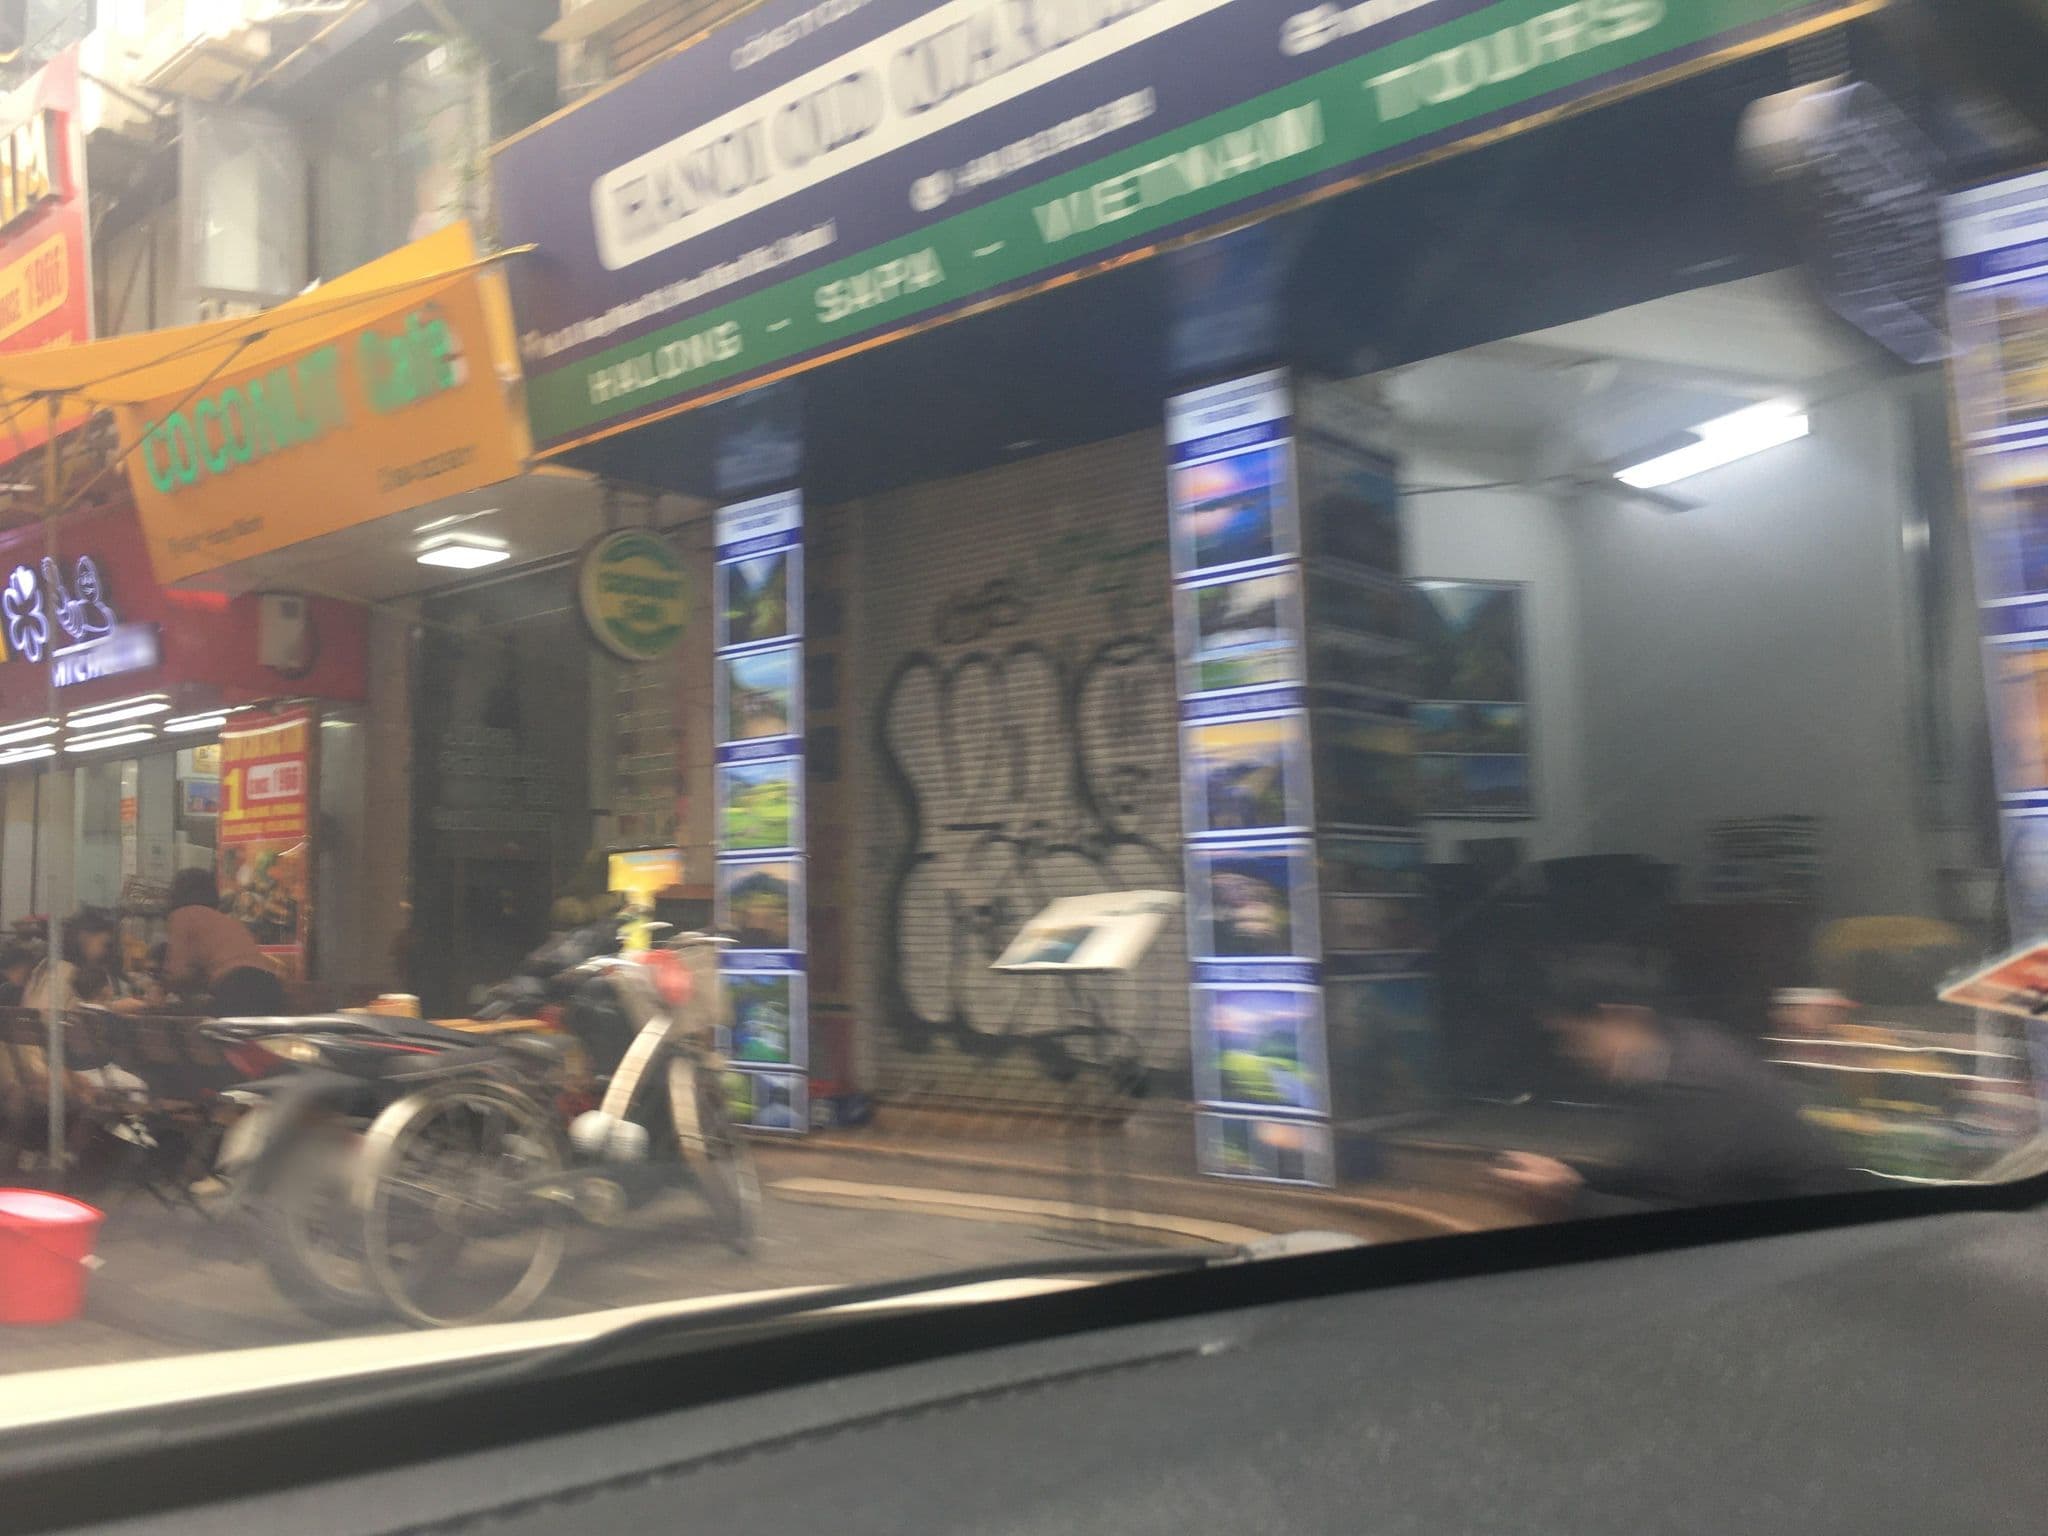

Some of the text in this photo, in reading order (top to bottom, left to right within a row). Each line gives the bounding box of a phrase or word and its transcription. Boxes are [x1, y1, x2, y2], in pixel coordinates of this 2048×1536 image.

[588, 319, 743, 407] HALONG
[815, 245, 946, 326] SAPA
[1362, 0, 1666, 123] TOURS
[140, 342, 350, 495] COCONUT
